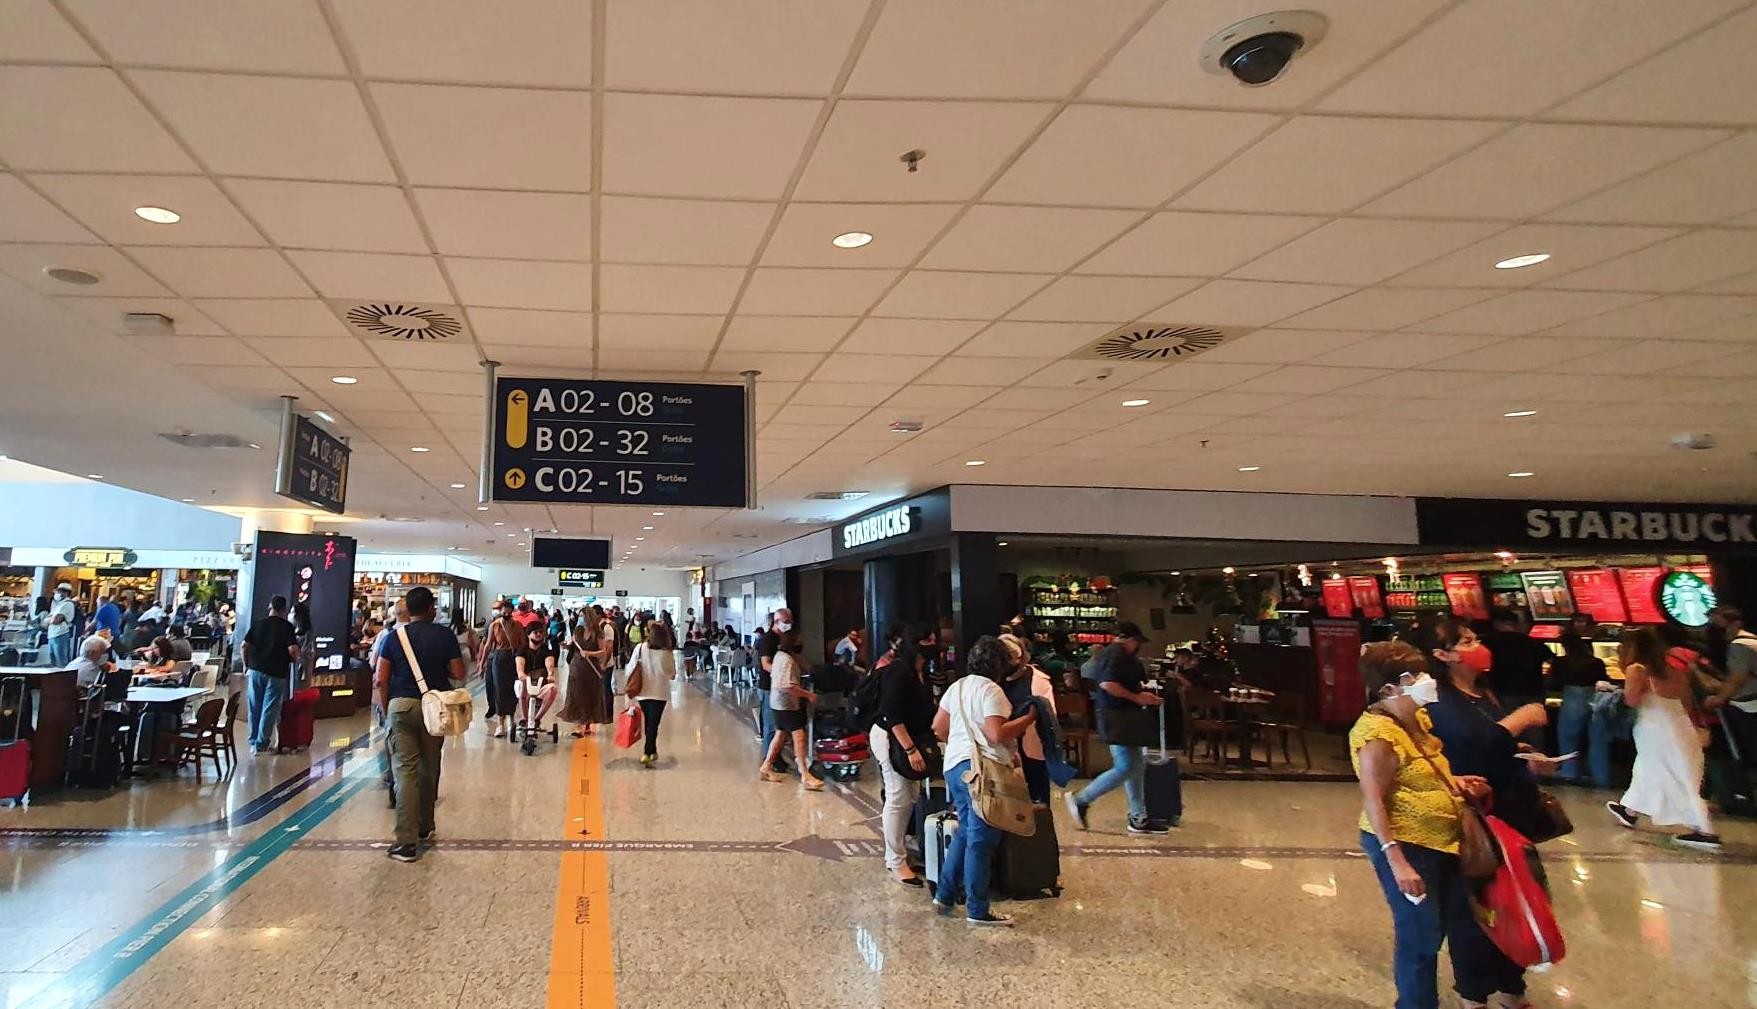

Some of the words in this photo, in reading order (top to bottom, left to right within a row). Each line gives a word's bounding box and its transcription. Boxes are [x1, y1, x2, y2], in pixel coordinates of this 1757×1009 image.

[534, 389, 556, 412] A
[561, 390, 595, 414] 02
[618, 392, 654, 416] 08
[662, 396, 692, 404] Portões
[536, 427, 553, 452] B
[560, 428, 594, 453] 02
[616, 430, 648, 454] 32
[662, 434, 692, 444] Portões
[535, 467, 554, 492] C
[558, 468, 593, 493] 02
[616, 470, 643, 495] 15
[656, 473, 687, 482] Portões
[844, 506, 910, 549] STARBUCKS
[1526, 508, 1757, 542] STARBUCK
